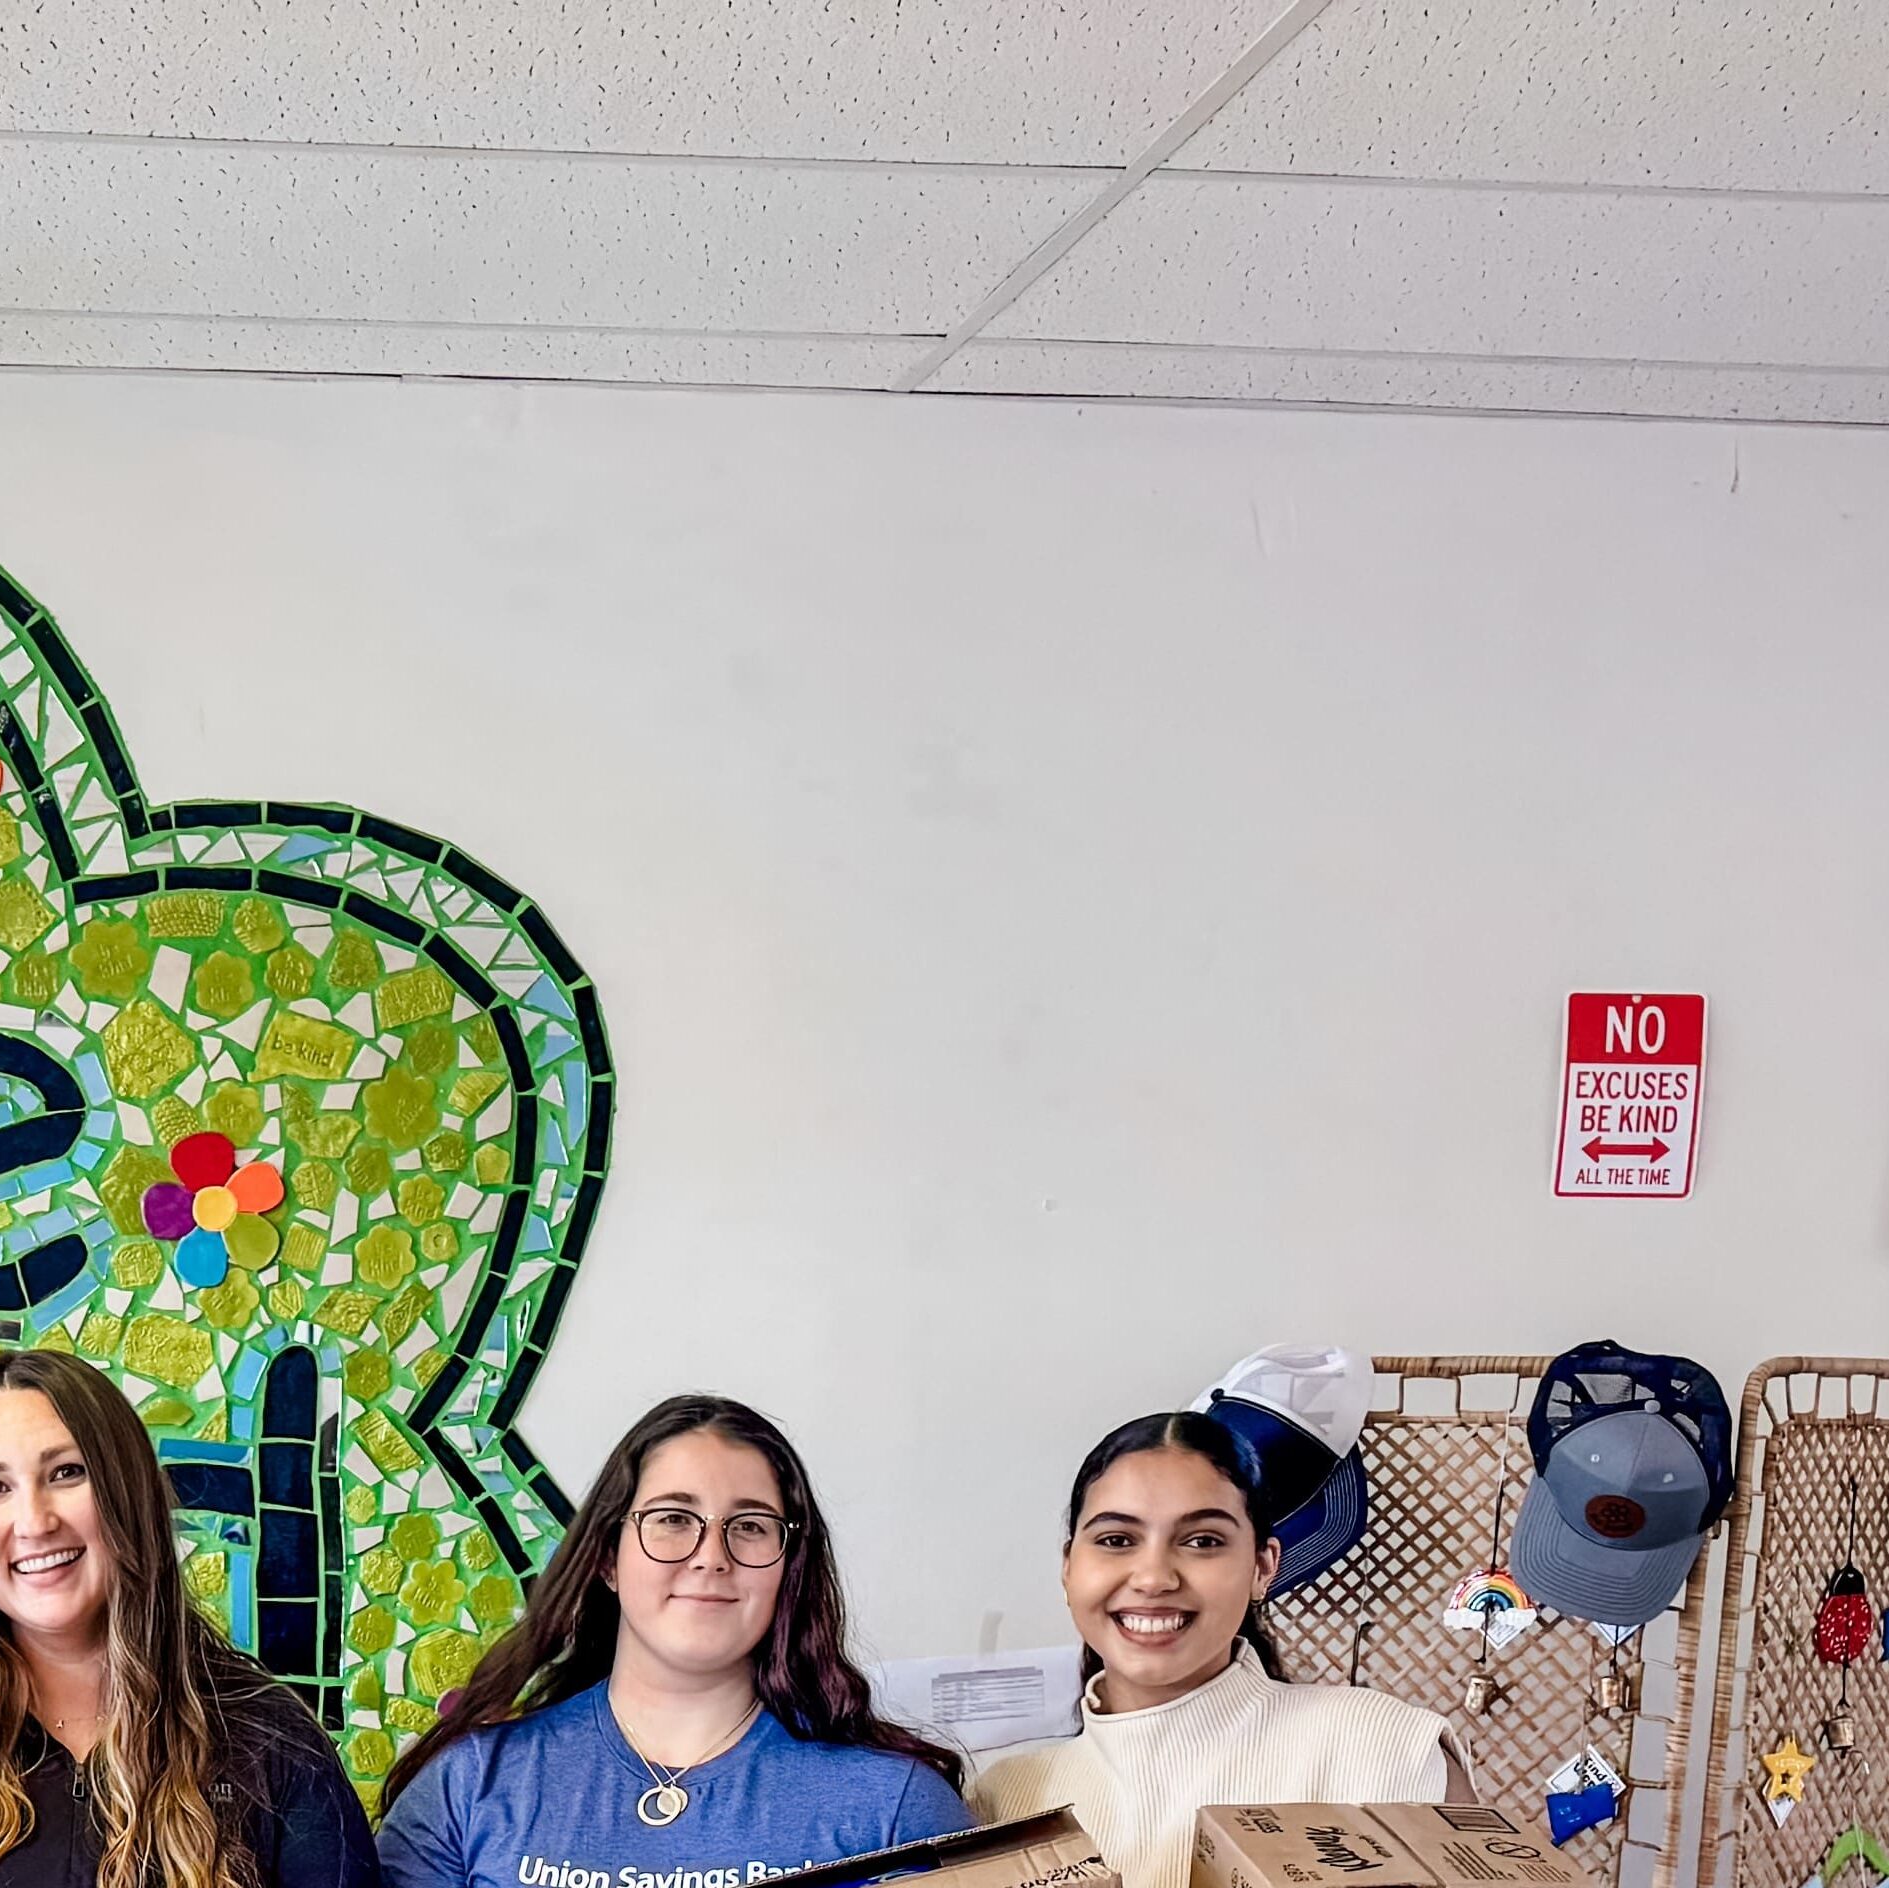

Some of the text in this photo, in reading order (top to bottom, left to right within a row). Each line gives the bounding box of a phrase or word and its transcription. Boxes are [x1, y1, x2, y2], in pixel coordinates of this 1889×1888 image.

[1604, 1004, 1666, 1055] NO
[1575, 1071, 1689, 1101] EXCUSES
[1580, 1105, 1679, 1133] BE KIND
[1575, 1168, 1671, 1186] ALL THE TIME
